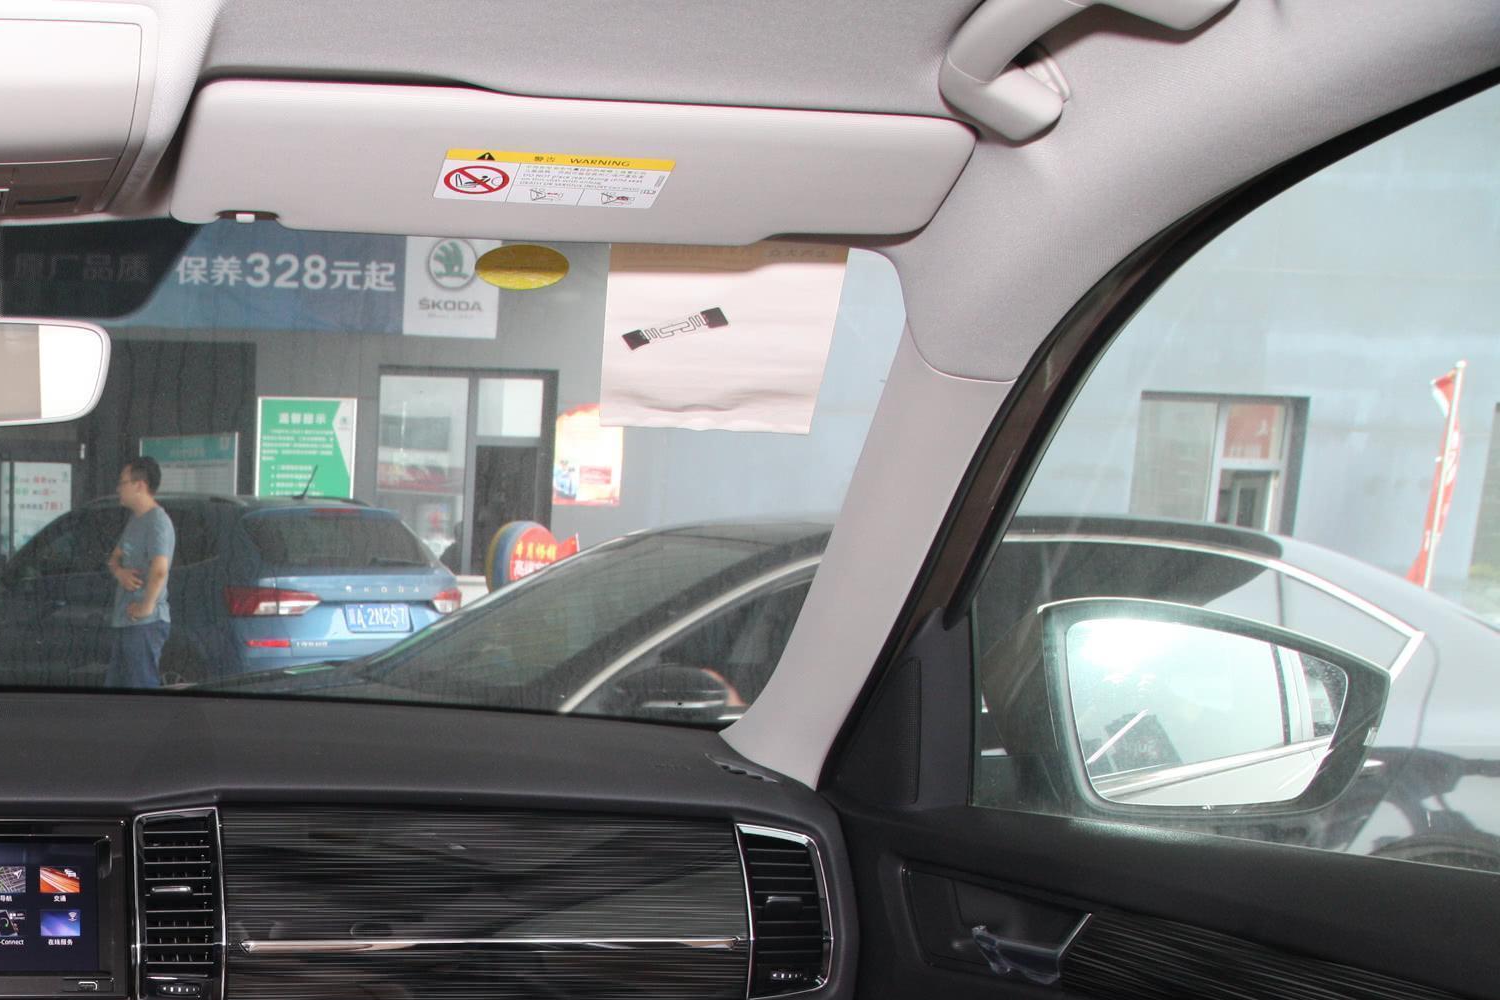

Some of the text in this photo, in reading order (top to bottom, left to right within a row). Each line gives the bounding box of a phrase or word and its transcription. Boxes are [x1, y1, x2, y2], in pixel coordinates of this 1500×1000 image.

[569, 157, 632, 168] WARNING
[175, 252, 397, 293] 保养328元起
